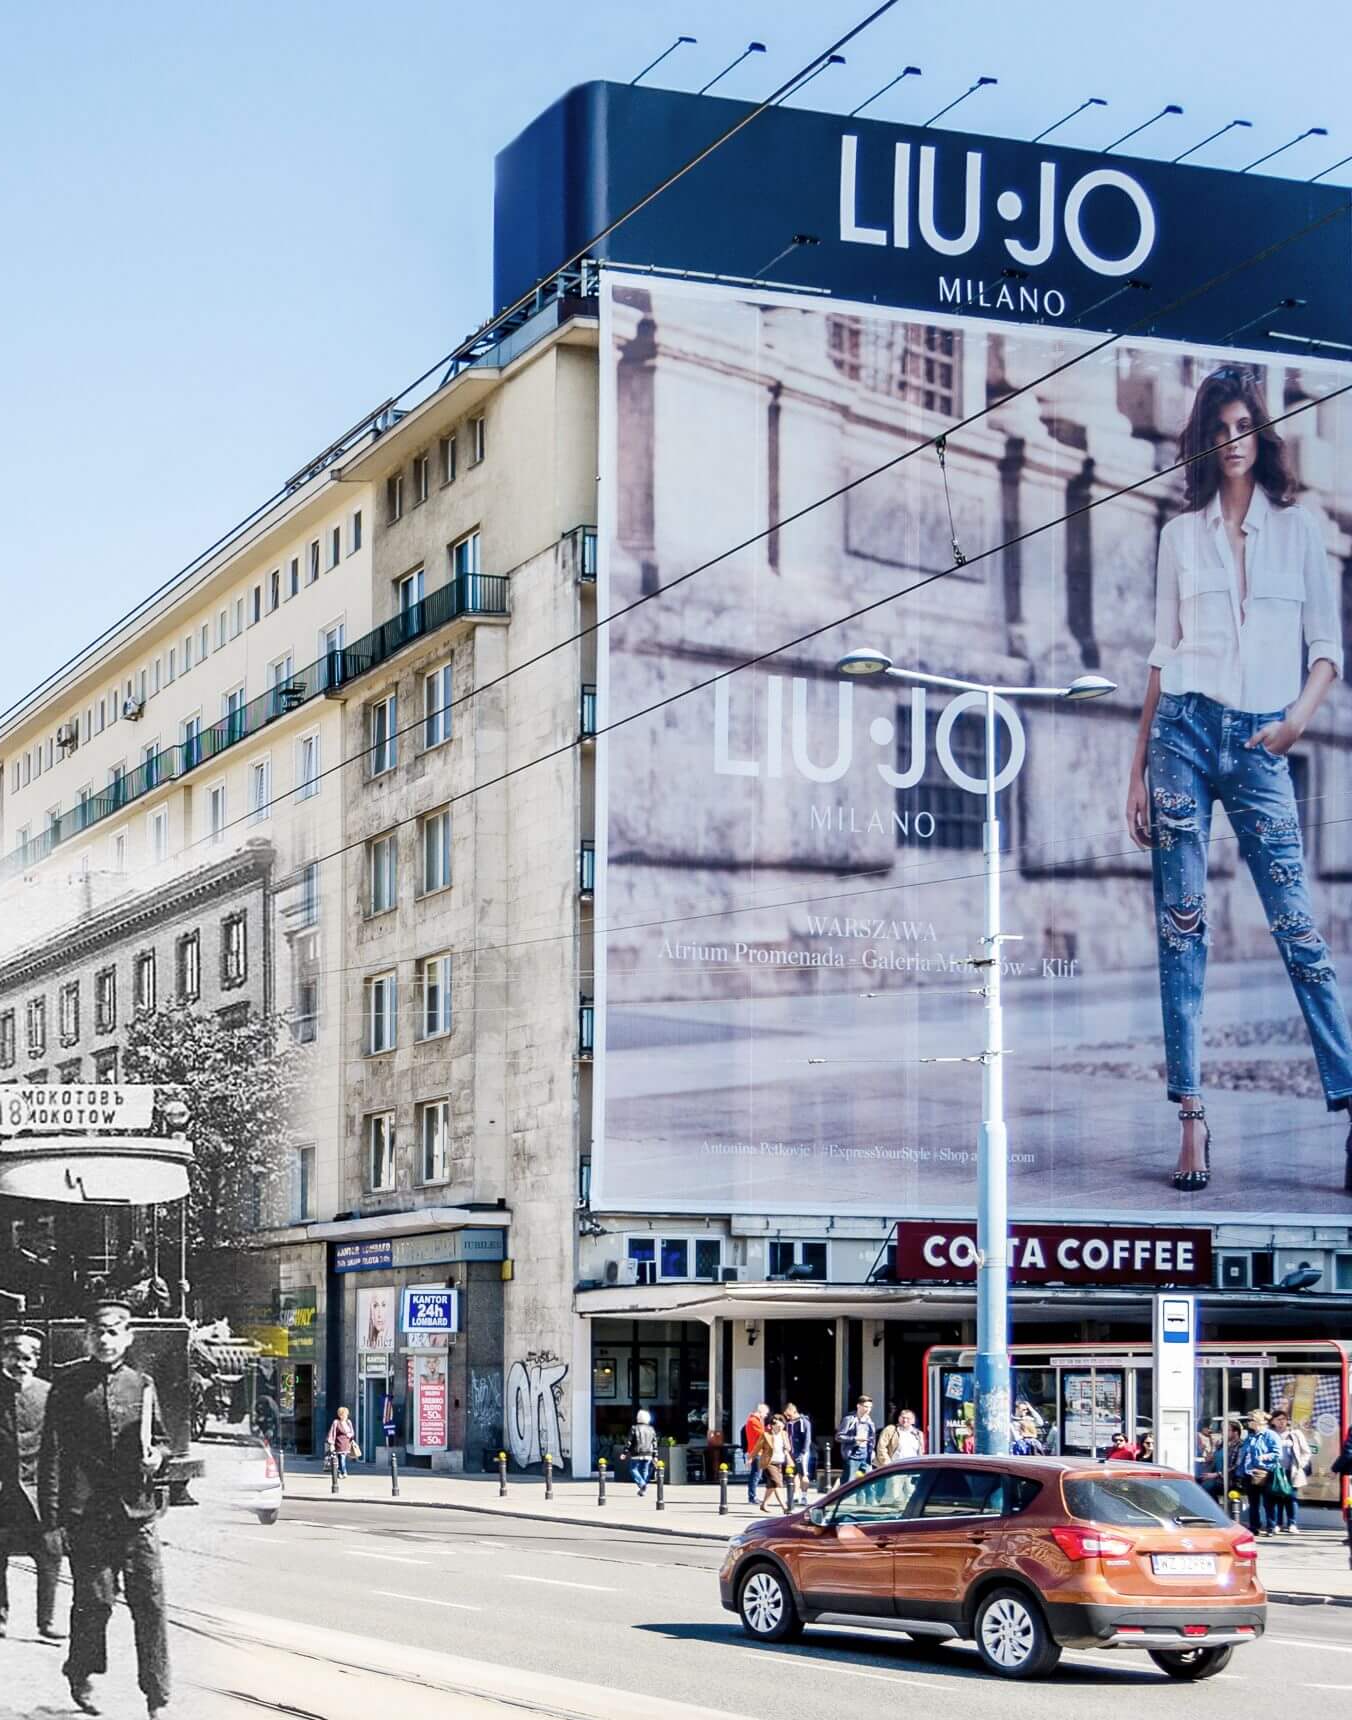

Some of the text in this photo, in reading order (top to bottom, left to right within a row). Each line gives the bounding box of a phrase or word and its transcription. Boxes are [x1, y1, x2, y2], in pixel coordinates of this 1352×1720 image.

[938, 275, 1066, 318] MILANO
[809, 804, 936, 839] MILANO
[807, 915, 937, 943] WARSZAWA
[658, 939, 729, 962] Atrium
[735, 942, 845, 968] Promenada
[862, 949, 931, 973] Galeria
[1041, 957, 1079, 979] Klif
[922, 1235, 1195, 1271] COTA COFFEE
[412, 1295, 448, 1304] KANTOR
[417, 1303, 444, 1318] 24h
[279, 1306, 316, 1327] SUBWAY
[411, 1317, 448, 1326] LOMBARD
